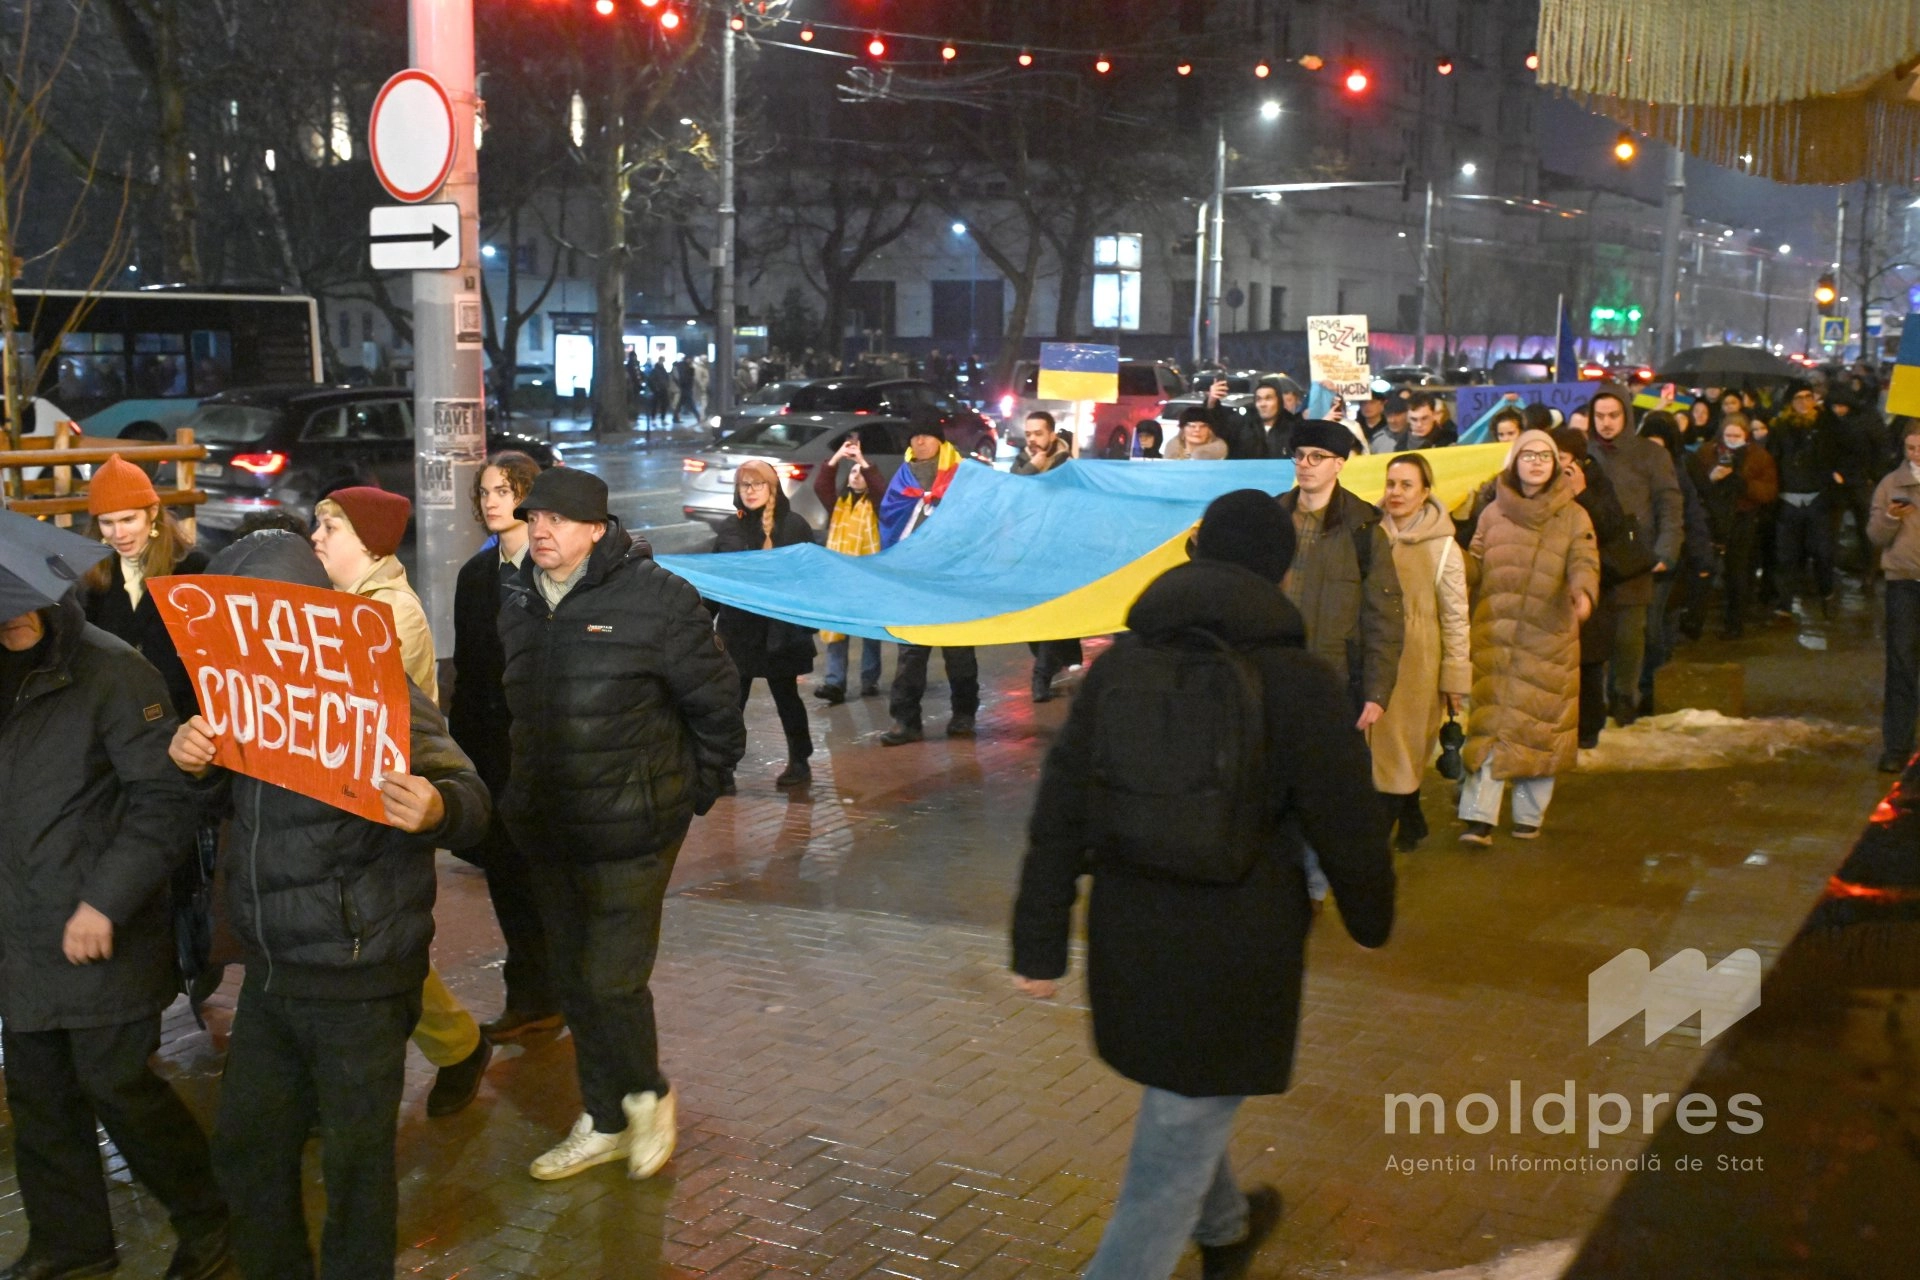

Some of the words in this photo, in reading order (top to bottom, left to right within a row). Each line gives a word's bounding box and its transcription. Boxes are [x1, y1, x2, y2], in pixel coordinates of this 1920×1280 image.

[434, 409, 470, 425] RAVE
[225, 593, 353, 687] ГДЕ
[198, 665, 407, 790] СОВЕСТЬ
